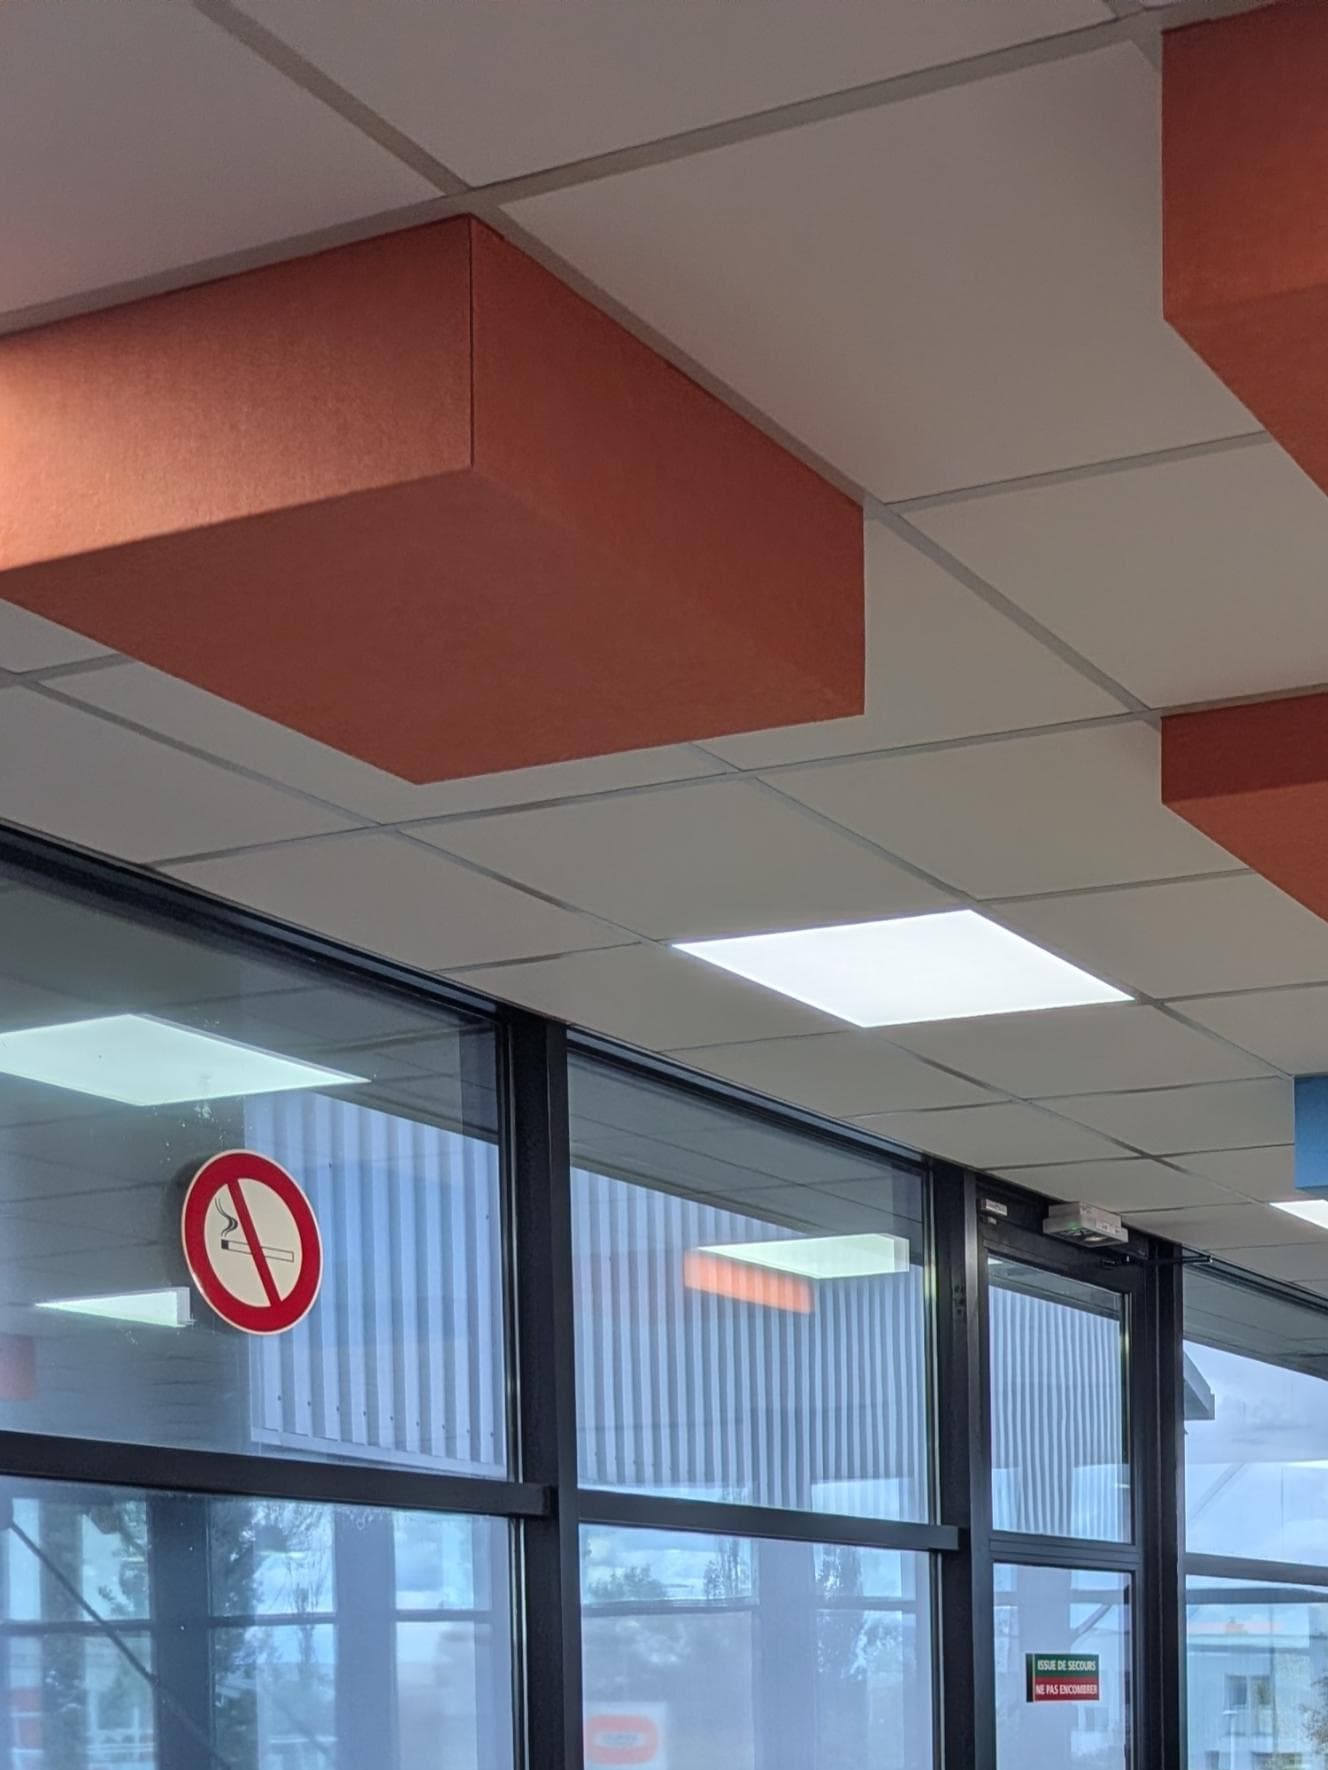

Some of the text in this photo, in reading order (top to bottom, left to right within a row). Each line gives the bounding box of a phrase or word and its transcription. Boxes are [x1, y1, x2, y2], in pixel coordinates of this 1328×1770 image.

[1037, 1659, 1097, 1671] ISSUE DE SECOURS
[1035, 1684, 1098, 1695] NE PAS ENCOMBRER
